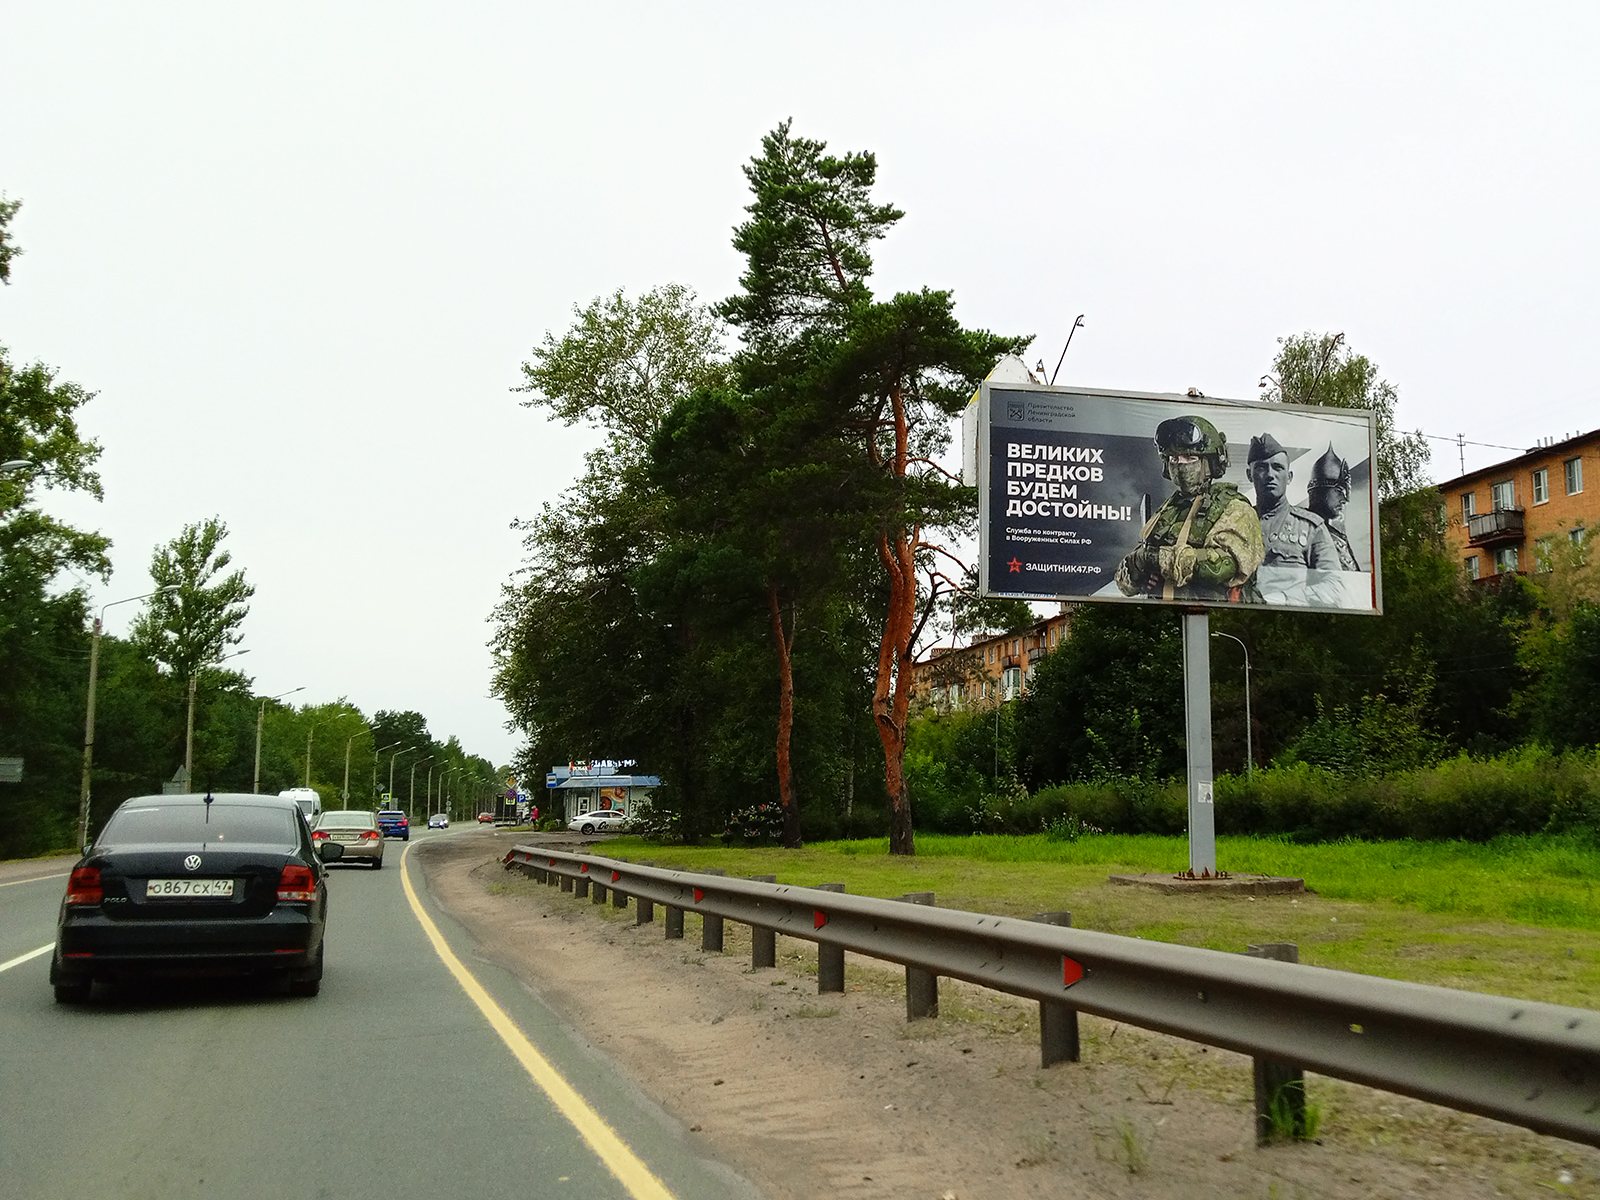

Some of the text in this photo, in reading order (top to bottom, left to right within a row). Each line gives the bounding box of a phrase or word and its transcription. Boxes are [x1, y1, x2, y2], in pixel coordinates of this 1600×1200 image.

[1007, 443, 1104, 464] ВЕЛИКИХ
[1007, 462, 1104, 482] ПРЕДКОВ
[1007, 481, 1078, 500] БУДЕМ
[1006, 499, 1131, 521] ДОСТОЙНЫ!
[1005, 527, 1031, 535] Служба
[1042, 529, 1077, 538] контракту
[1011, 535, 1058, 543] Вооруженных
[1059, 537, 1080, 545] Силах
[1025, 562, 1102, 574] ЗАЩИТНИК47.РФ
